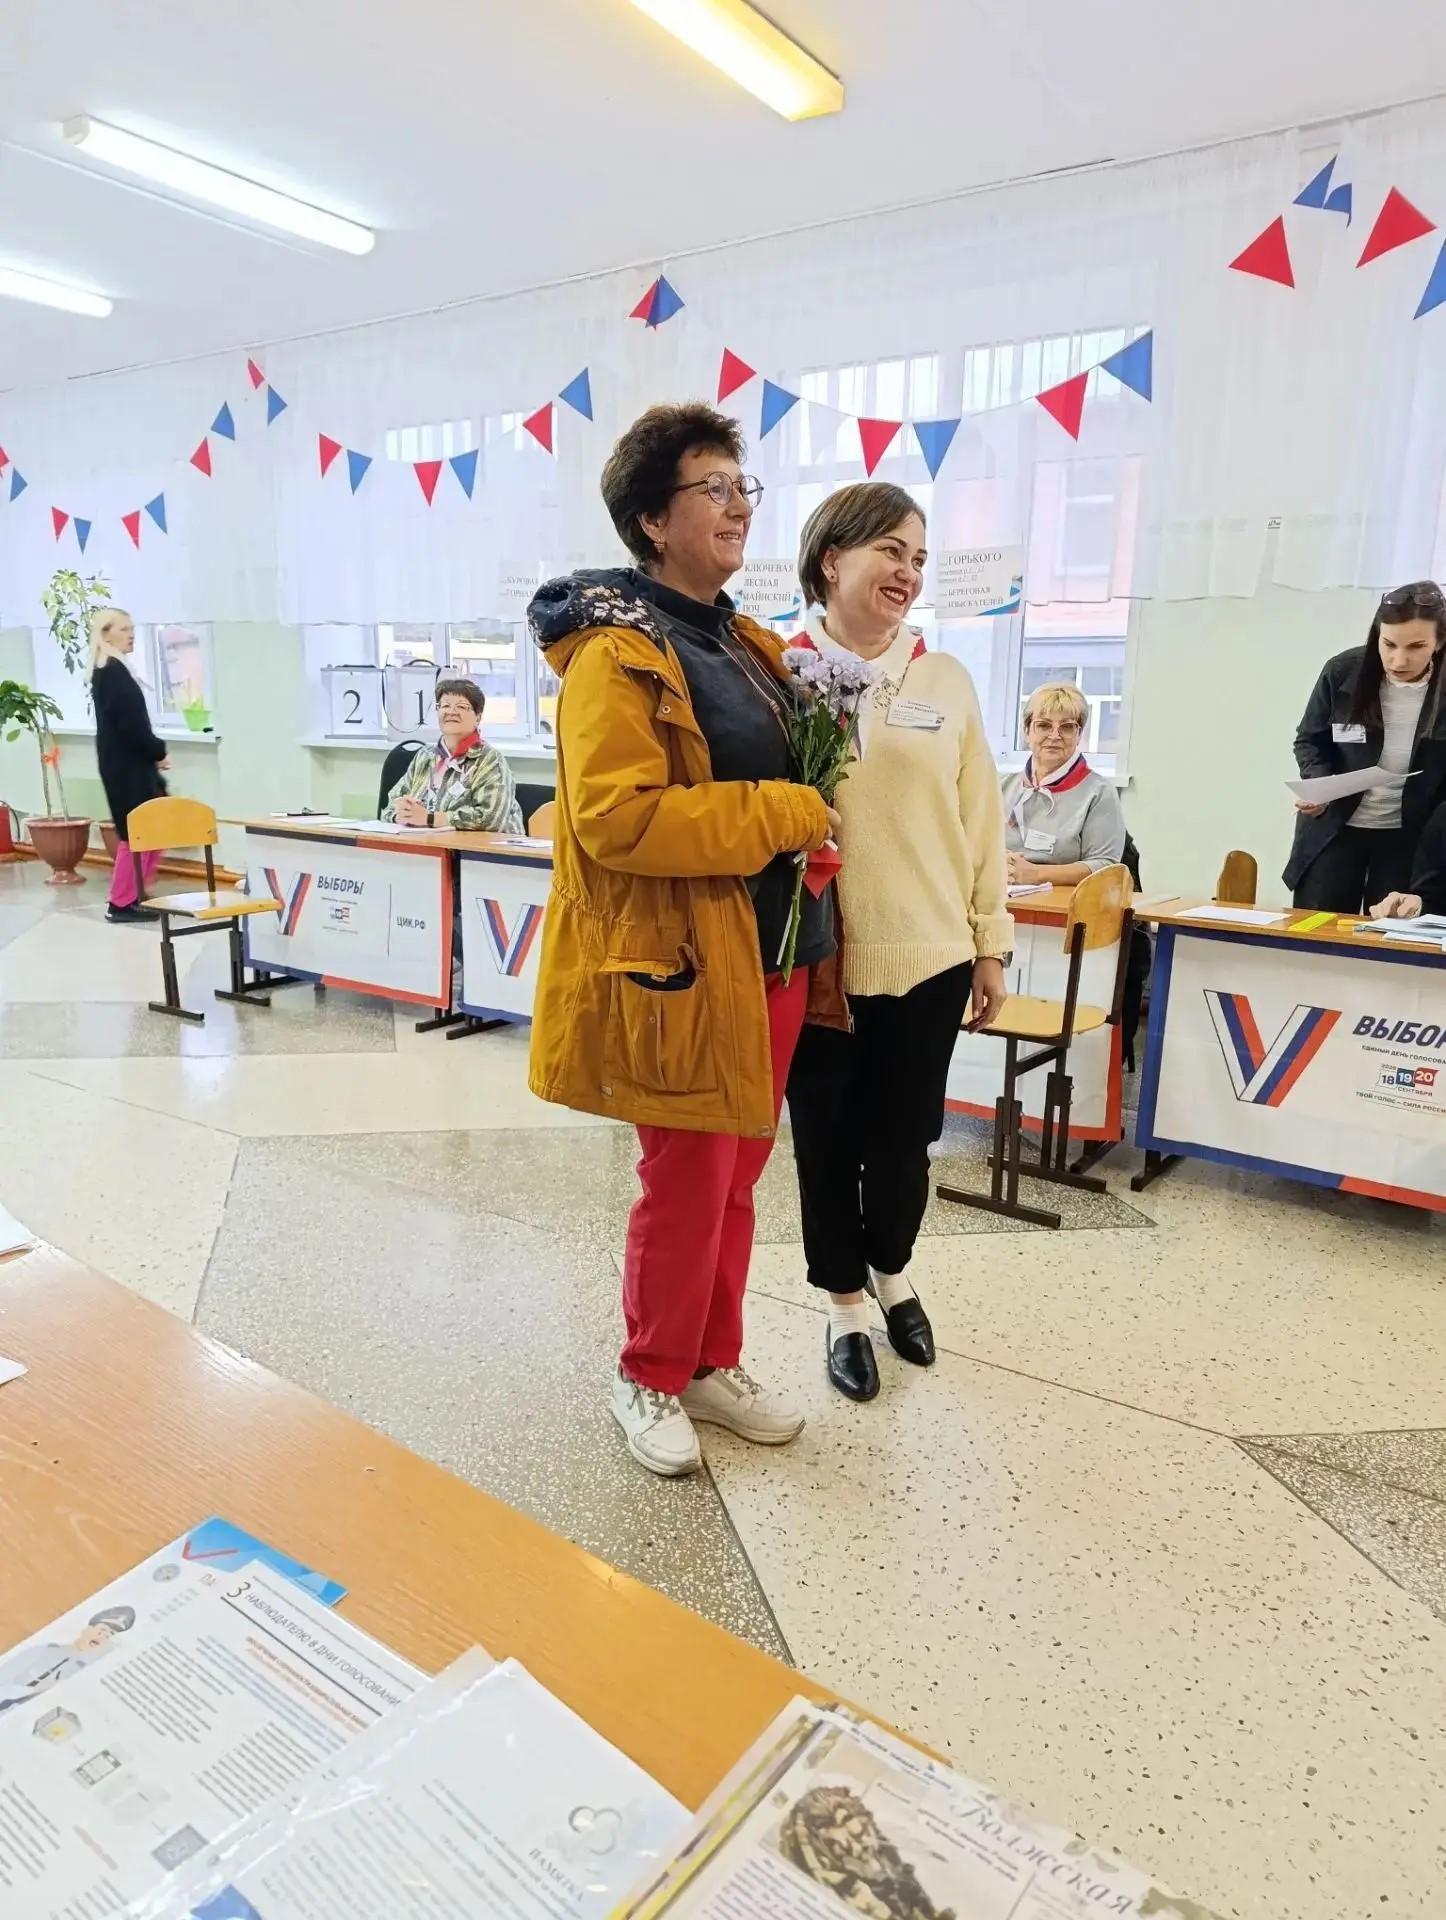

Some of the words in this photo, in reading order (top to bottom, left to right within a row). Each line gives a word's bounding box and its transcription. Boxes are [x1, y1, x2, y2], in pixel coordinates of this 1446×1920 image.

[744, 563, 794, 573] КЛЮЧЕВАЯ
[343, 689, 363, 724] 2
[413, 689, 427, 726] 1
[317, 875, 364, 895] ВЫБОРЫ
[1361, 1044, 1390, 1055] ЕДИНЫЙ
[1391, 1049, 1408, 1059] ДЕНЬ
[1381, 1074, 1395, 1086] 18
[1398, 1071, 1413, 1084] 19
[1415, 1070, 1434, 1082] 20
[1355, 1091, 1374, 1099] ТВОЙ
[1374, 1094, 1396, 1104] ГОЛОС
[1403, 1101, 1421, 1110] СИЛА
[1397, 1086, 1433, 1097] СЕНТЯБРЯ
[226, 1581, 251, 1599] 3
[246, 1593, 310, 1644] НАБЛЮДАТЕЛЮ
[307, 1638, 317, 1649] В
[314, 1644, 338, 1667] ДНИ
